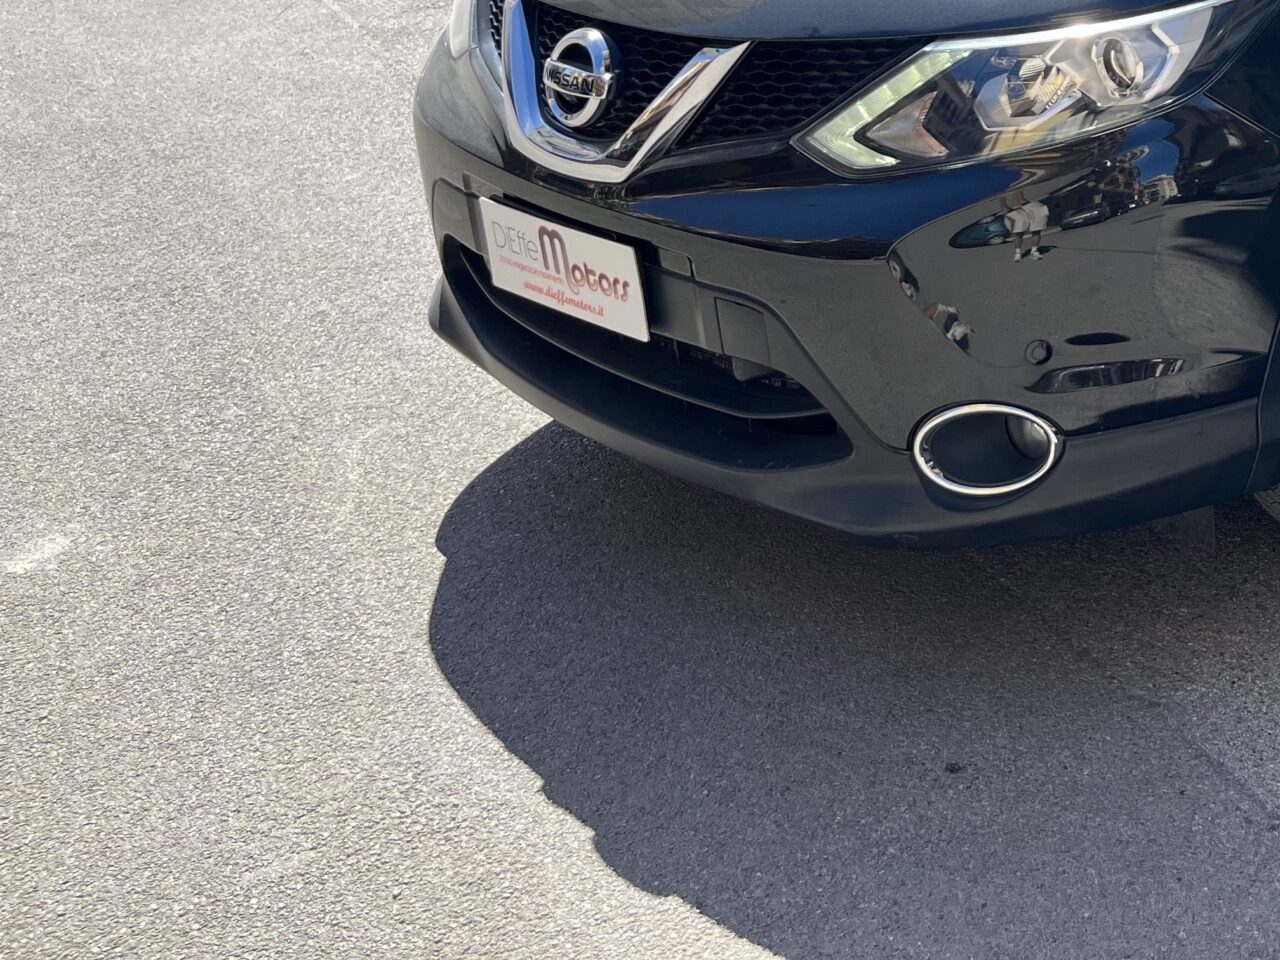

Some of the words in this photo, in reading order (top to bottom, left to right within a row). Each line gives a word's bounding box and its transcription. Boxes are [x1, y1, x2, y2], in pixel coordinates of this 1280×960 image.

[546, 68, 595, 93] NISSAN
[491, 221, 539, 261] DiEffe
[538, 225, 630, 302] Motors
